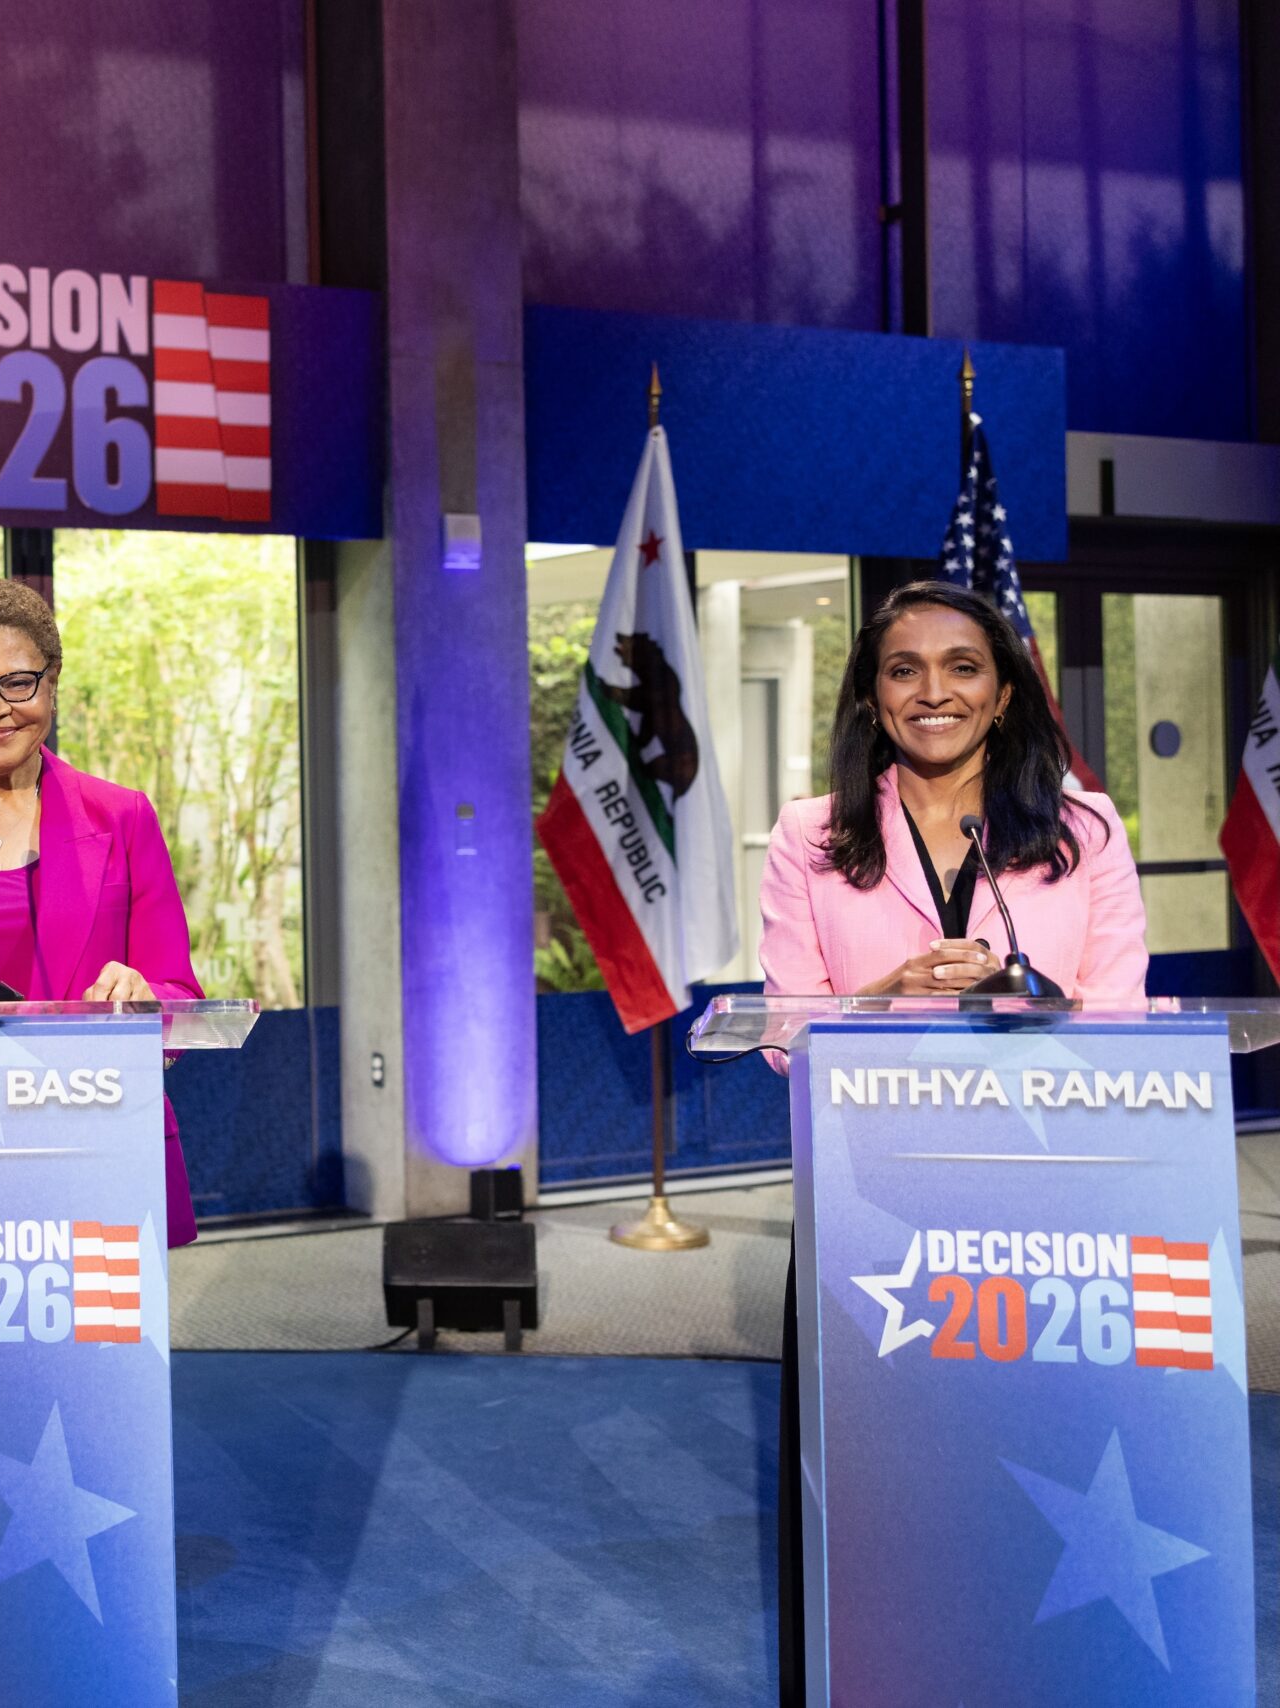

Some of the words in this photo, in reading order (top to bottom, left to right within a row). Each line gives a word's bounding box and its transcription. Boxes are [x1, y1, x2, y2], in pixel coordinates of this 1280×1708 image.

[594, 779, 667, 904] REPUBLIC
[7, 1068, 123, 1106] BASS
[831, 1067, 1009, 1107] NITHYA
[1023, 1070, 1213, 1108] RAMAN
[927, 1229, 1129, 1277] DECISION
[928, 1274, 1132, 1366] 2026
